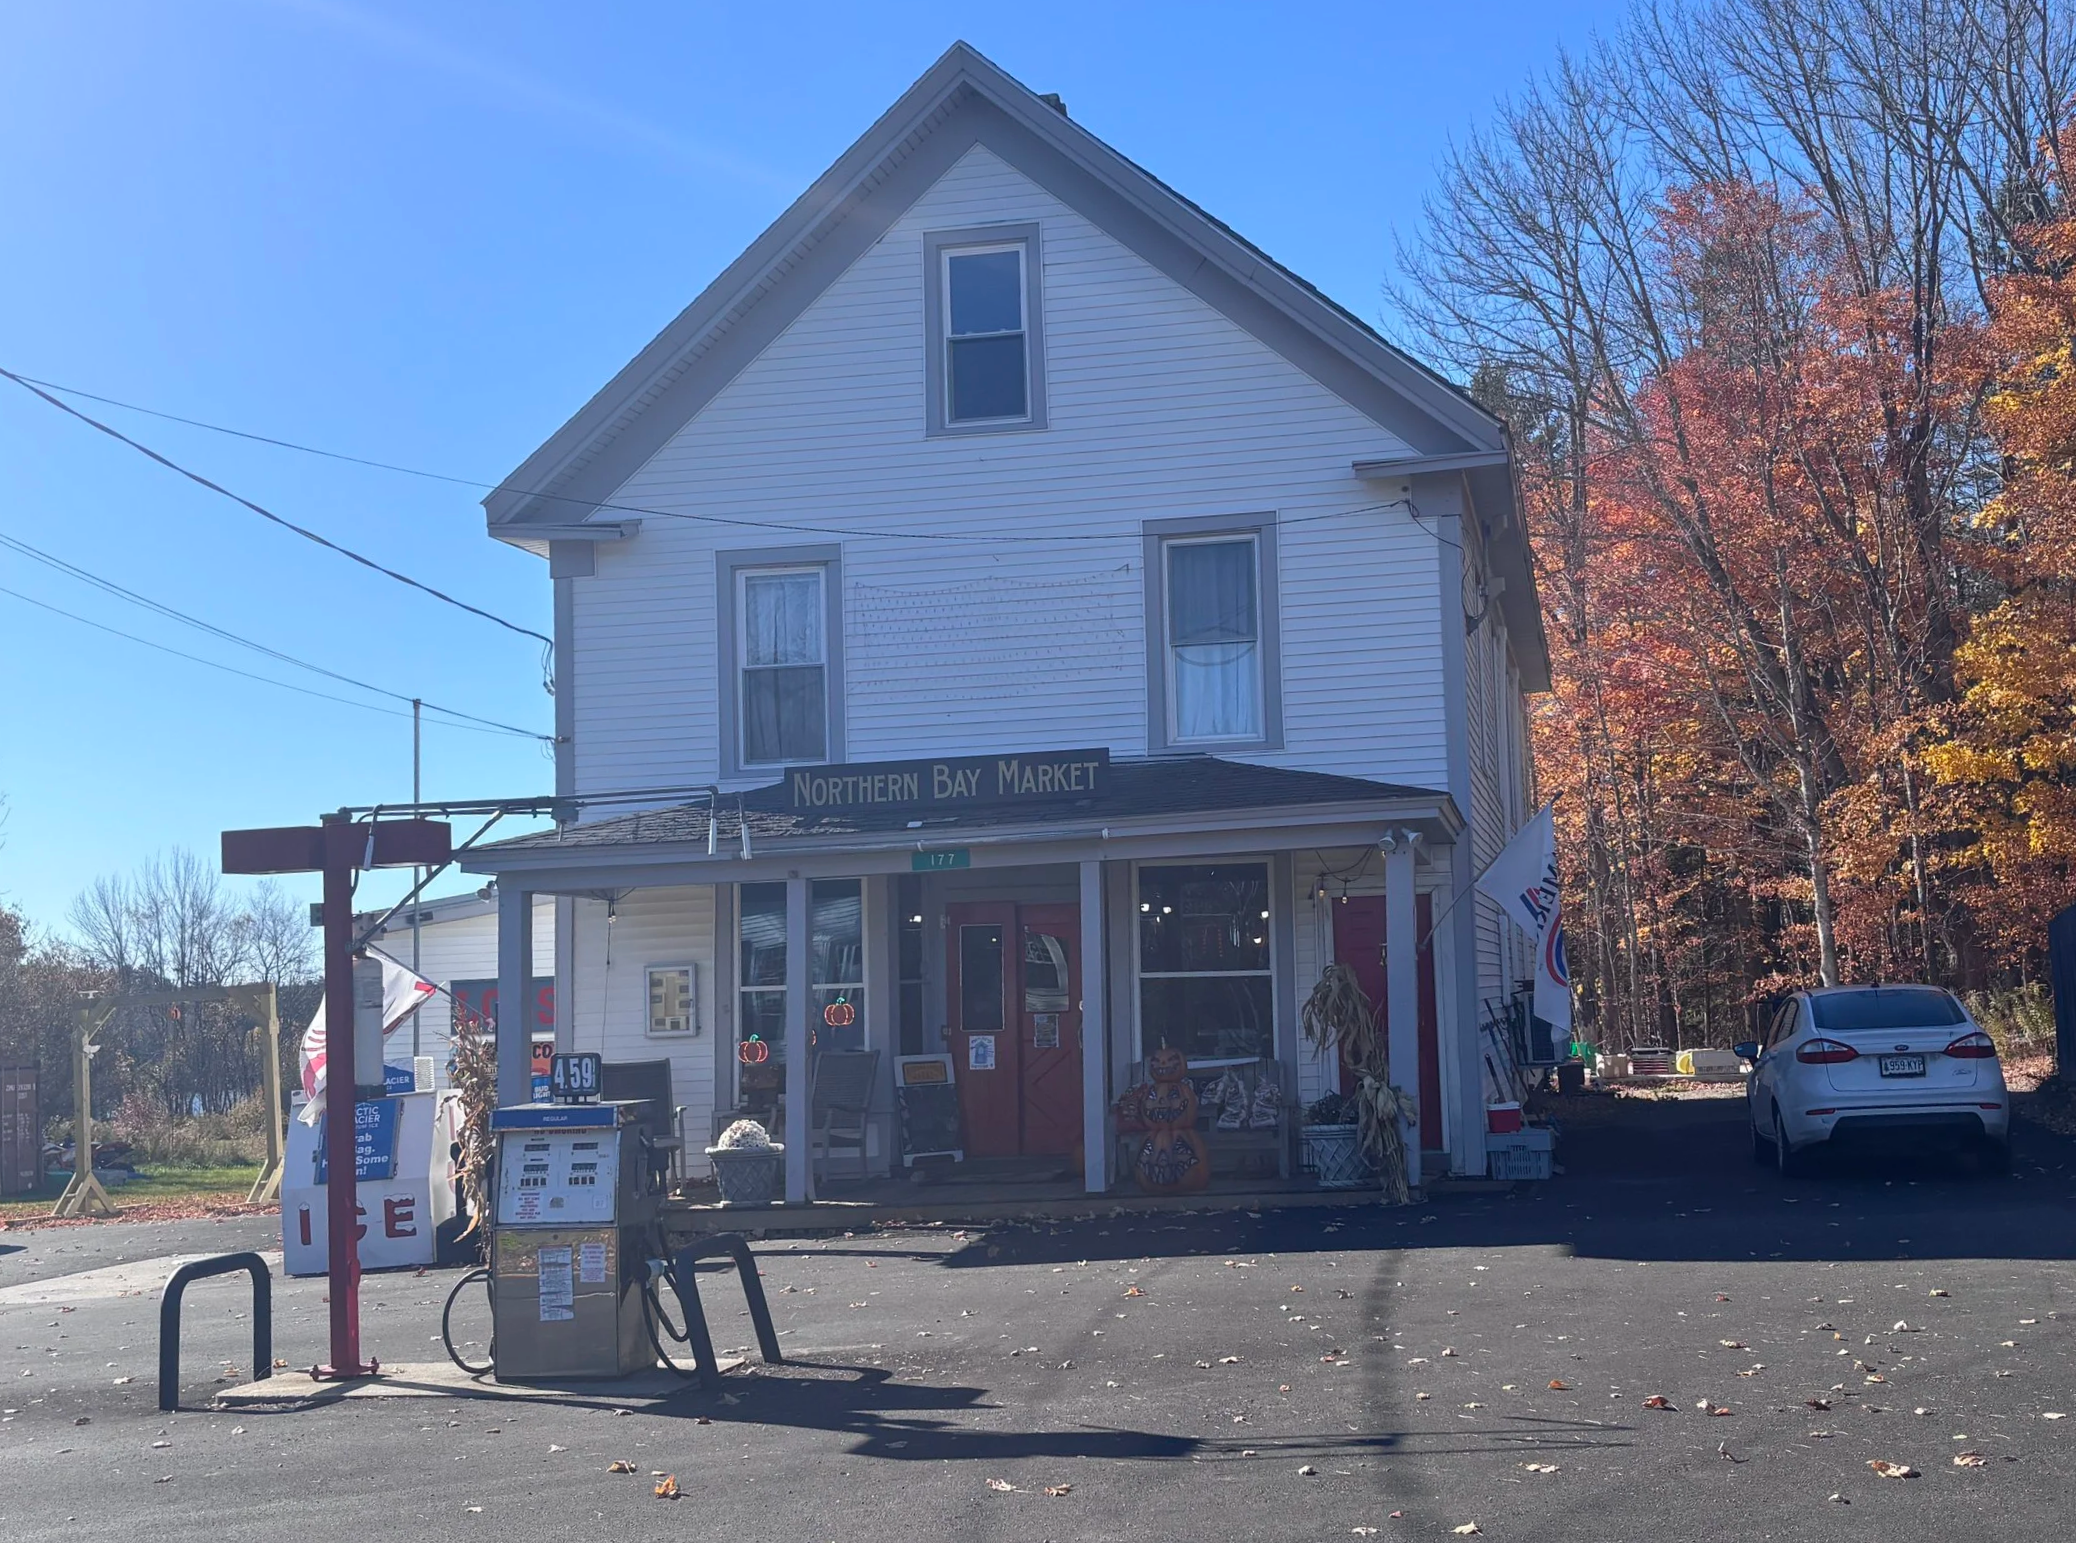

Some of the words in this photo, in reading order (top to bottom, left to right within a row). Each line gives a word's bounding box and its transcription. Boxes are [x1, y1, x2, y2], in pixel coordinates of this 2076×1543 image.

[933, 763, 982, 799] BAY
[998, 759, 1100, 795] MARKET
[930, 853, 955, 866] 177
[383, 1076, 410, 1085] ACIER
[355, 1106, 379, 1116] CTIC
[355, 1114, 381, 1124] CIER
[355, 1154, 389, 1165] Some
